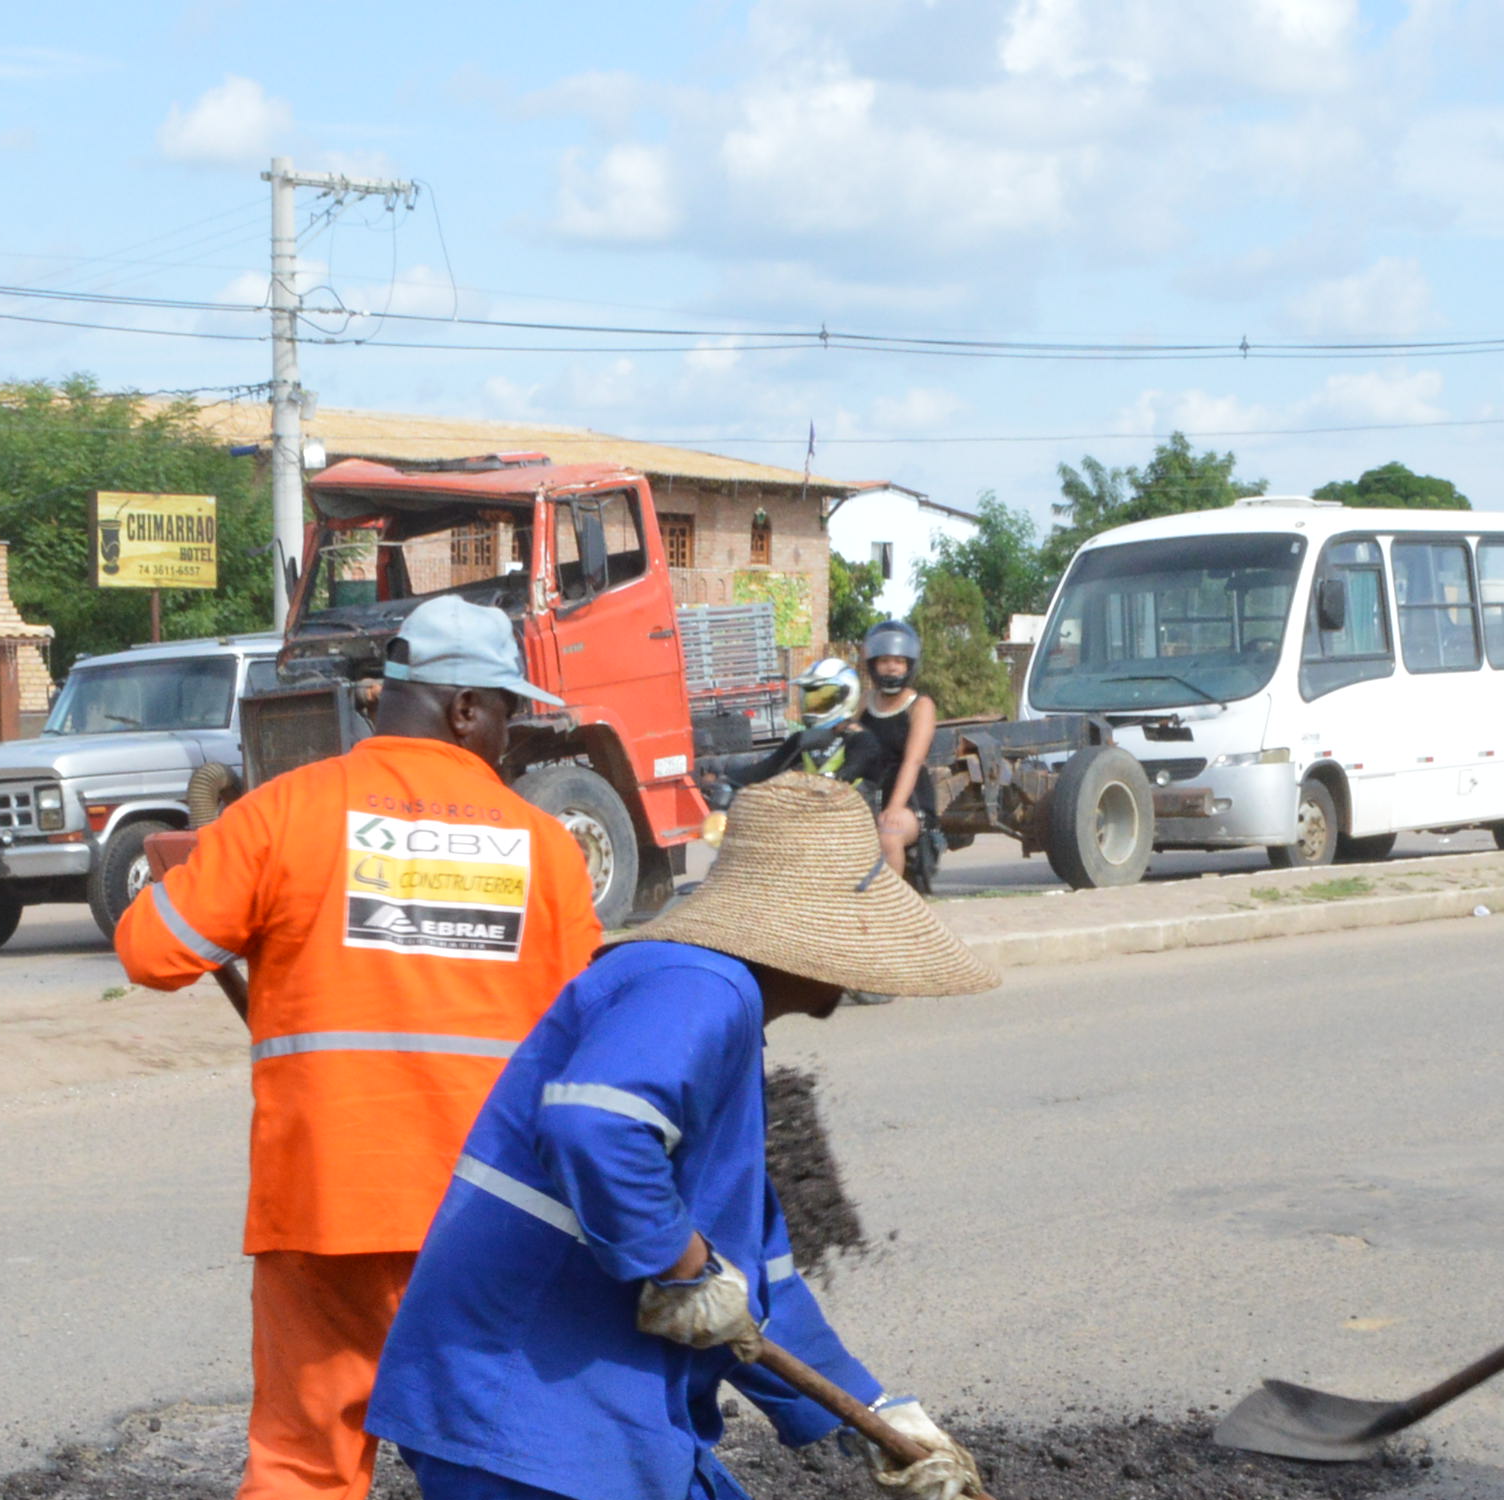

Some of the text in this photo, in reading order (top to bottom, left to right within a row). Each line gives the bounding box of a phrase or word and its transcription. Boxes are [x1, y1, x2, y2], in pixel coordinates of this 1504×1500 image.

[127, 507, 214, 544] CHIMARRÃO
[180, 547, 213, 562] HOTEL
[138, 565, 151, 574] 74
[366, 794, 502, 822] CONSORCIO
[406, 828, 522, 858] CBV
[399, 871, 525, 896] CONSTRUTERRA
